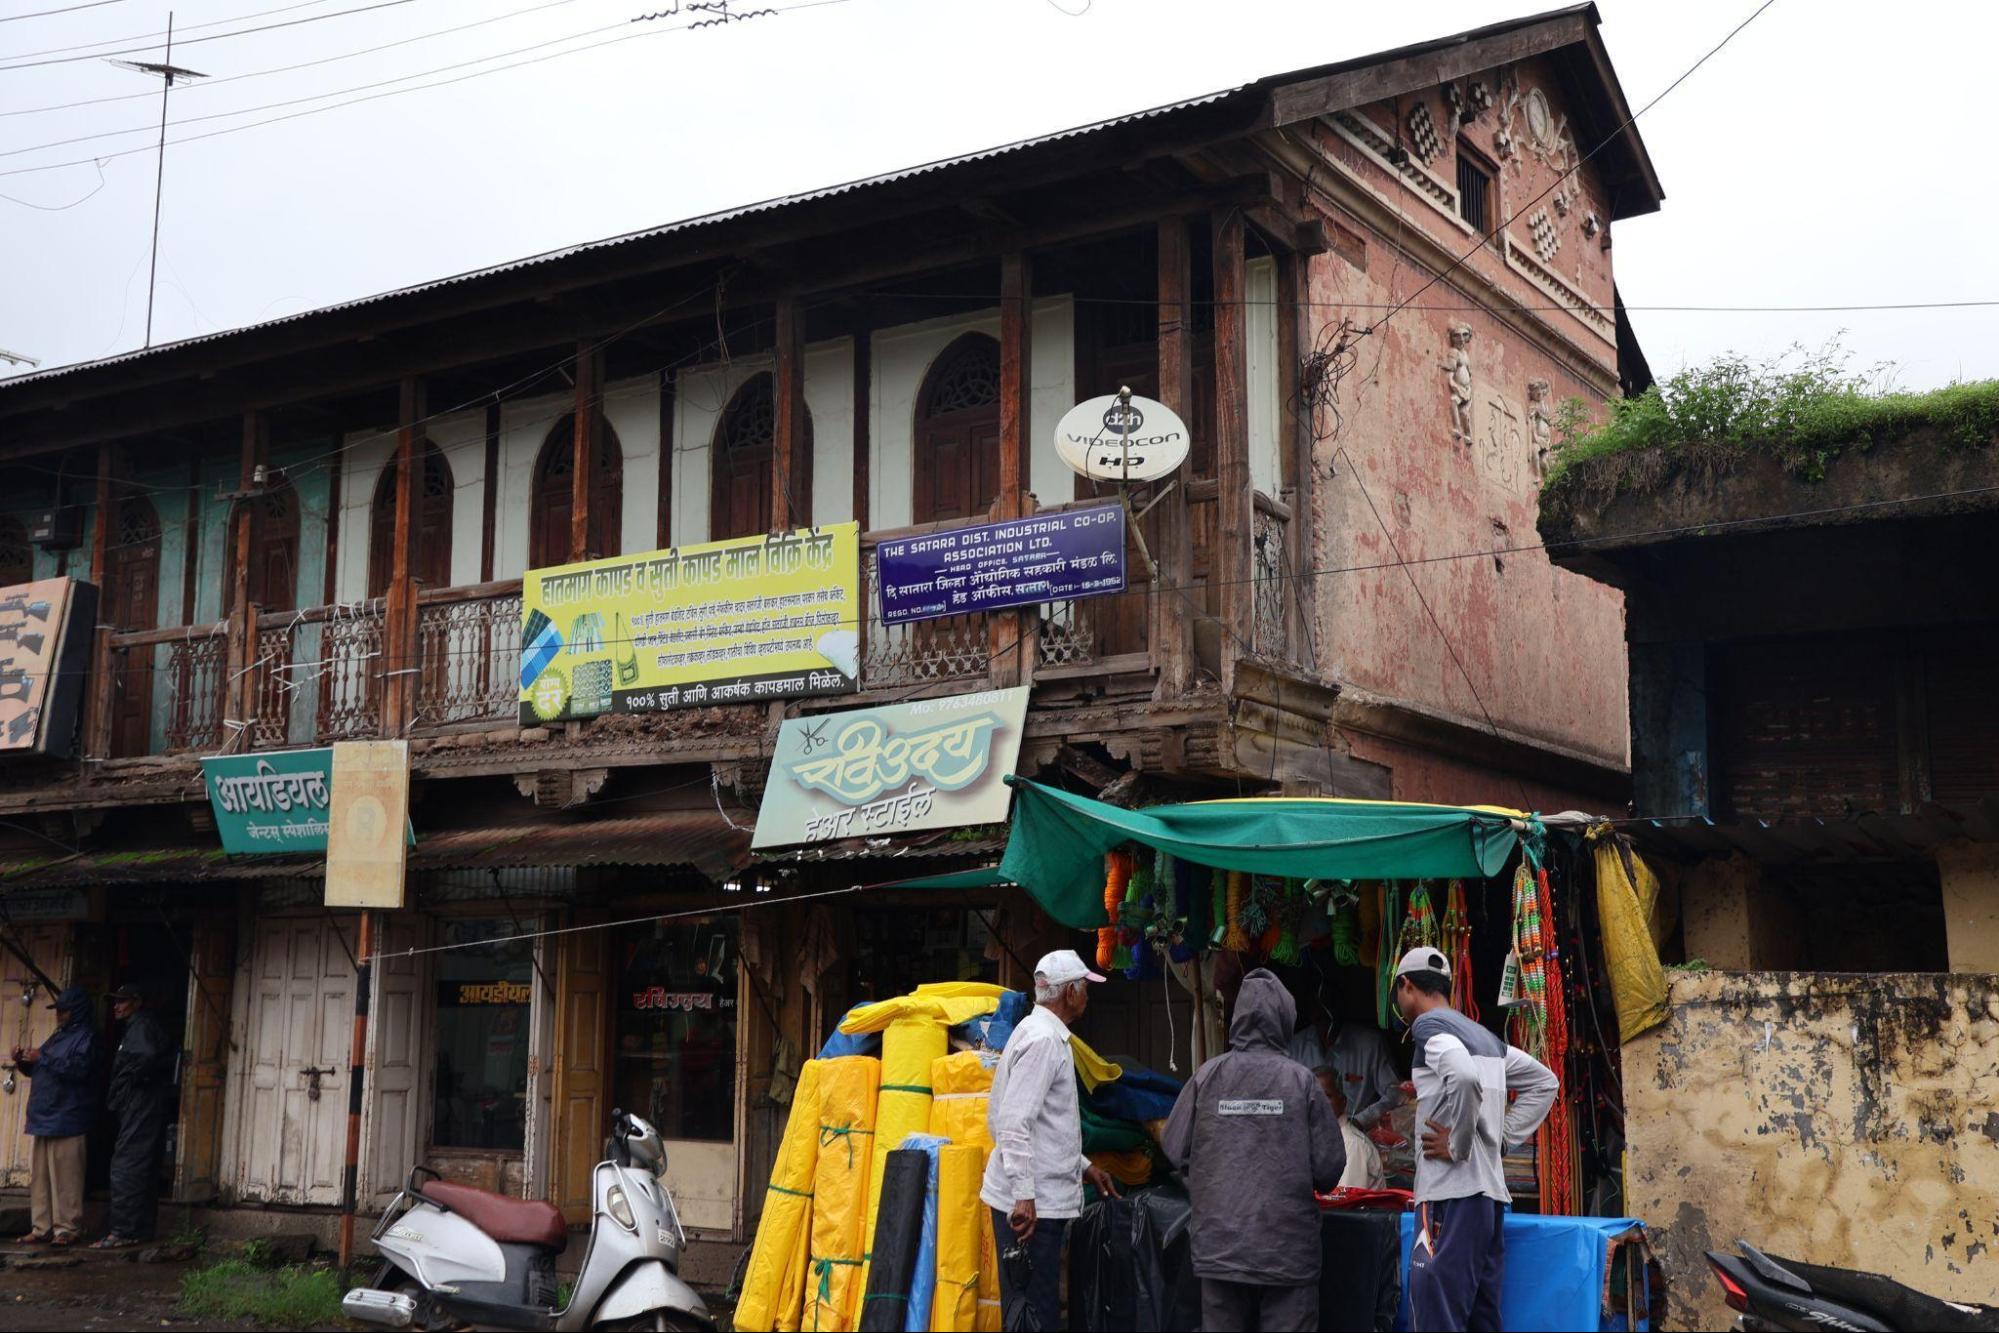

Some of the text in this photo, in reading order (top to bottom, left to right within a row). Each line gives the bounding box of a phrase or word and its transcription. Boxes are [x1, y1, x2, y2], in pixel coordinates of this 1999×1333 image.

[1067, 433, 1180, 446] VIDEOCON
[1099, 457, 1144, 466] HD
[885, 512, 1116, 557] THE SATARA DIST. INDUSTRIAL CO-OP.
[944, 537, 1052, 562] ASSOCIATION LTD.
[541, 569, 592, 606] हातमाग
[595, 563, 631, 597] कापड
[635, 563, 646, 593] व
[682, 549, 722, 586] कापड
[726, 544, 761, 575] माल
[886, 585, 898, 599] दि
[899, 581, 932, 596] सातारा
[936, 576, 966, 590] जिल्हा
[1025, 558, 1066, 577] सहकारी
[1070, 555, 1098, 569] मंडळ
[1101, 552, 1117, 565] लि.
[953, 592, 967, 604] हेड
[537, 688, 563, 712] दर
[626, 670, 845, 711] १००% सुती आणि आकर्षक कापडमाल मिळेल.
[215, 759, 329, 813] आयडियल
[861, 782, 936, 831] स्टाईल
